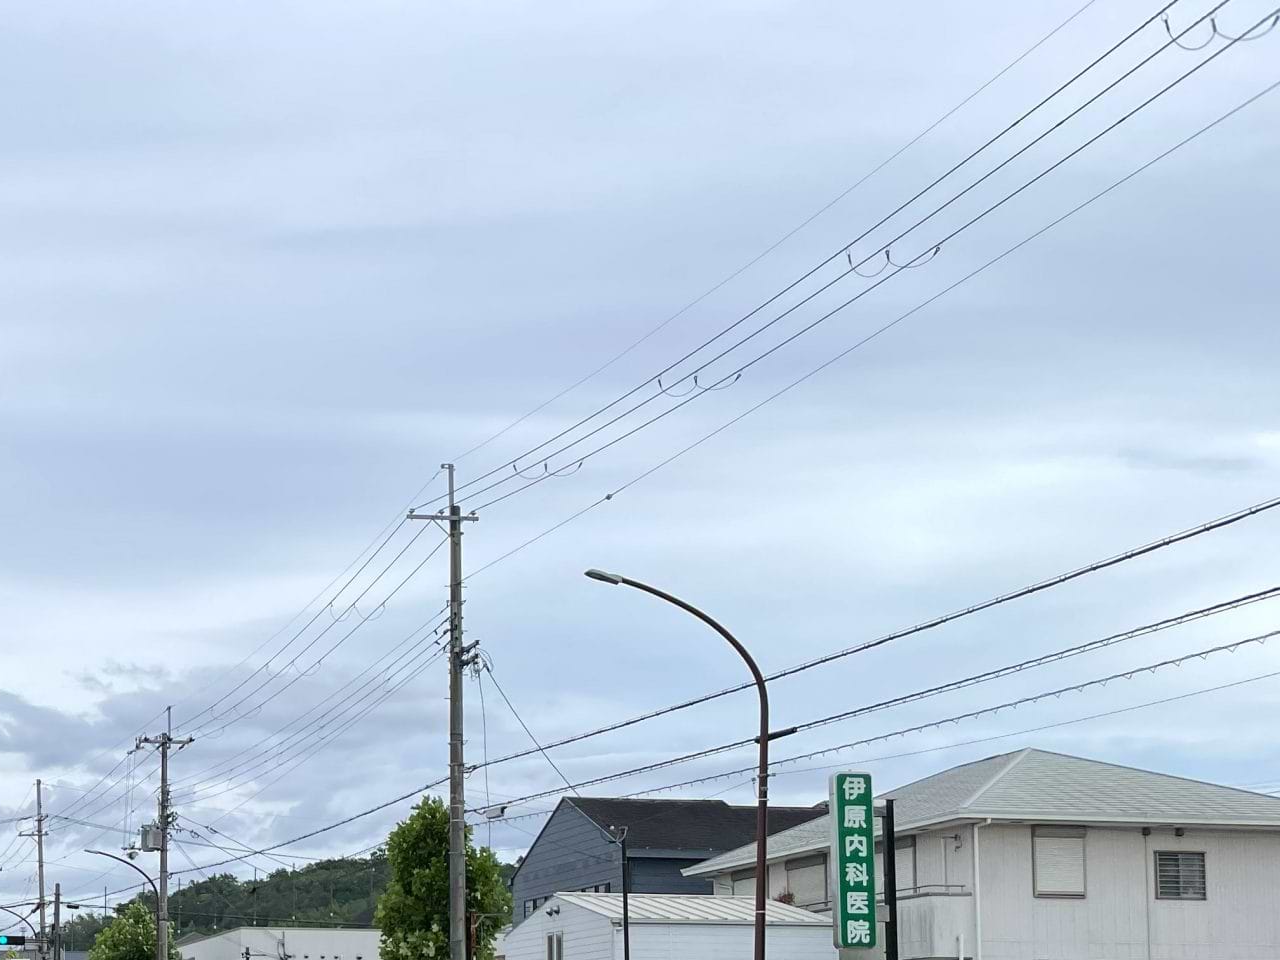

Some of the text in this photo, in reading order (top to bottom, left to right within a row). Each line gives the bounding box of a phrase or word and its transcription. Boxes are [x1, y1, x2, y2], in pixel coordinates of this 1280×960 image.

[842, 776, 870, 944] 伊原内科医院
